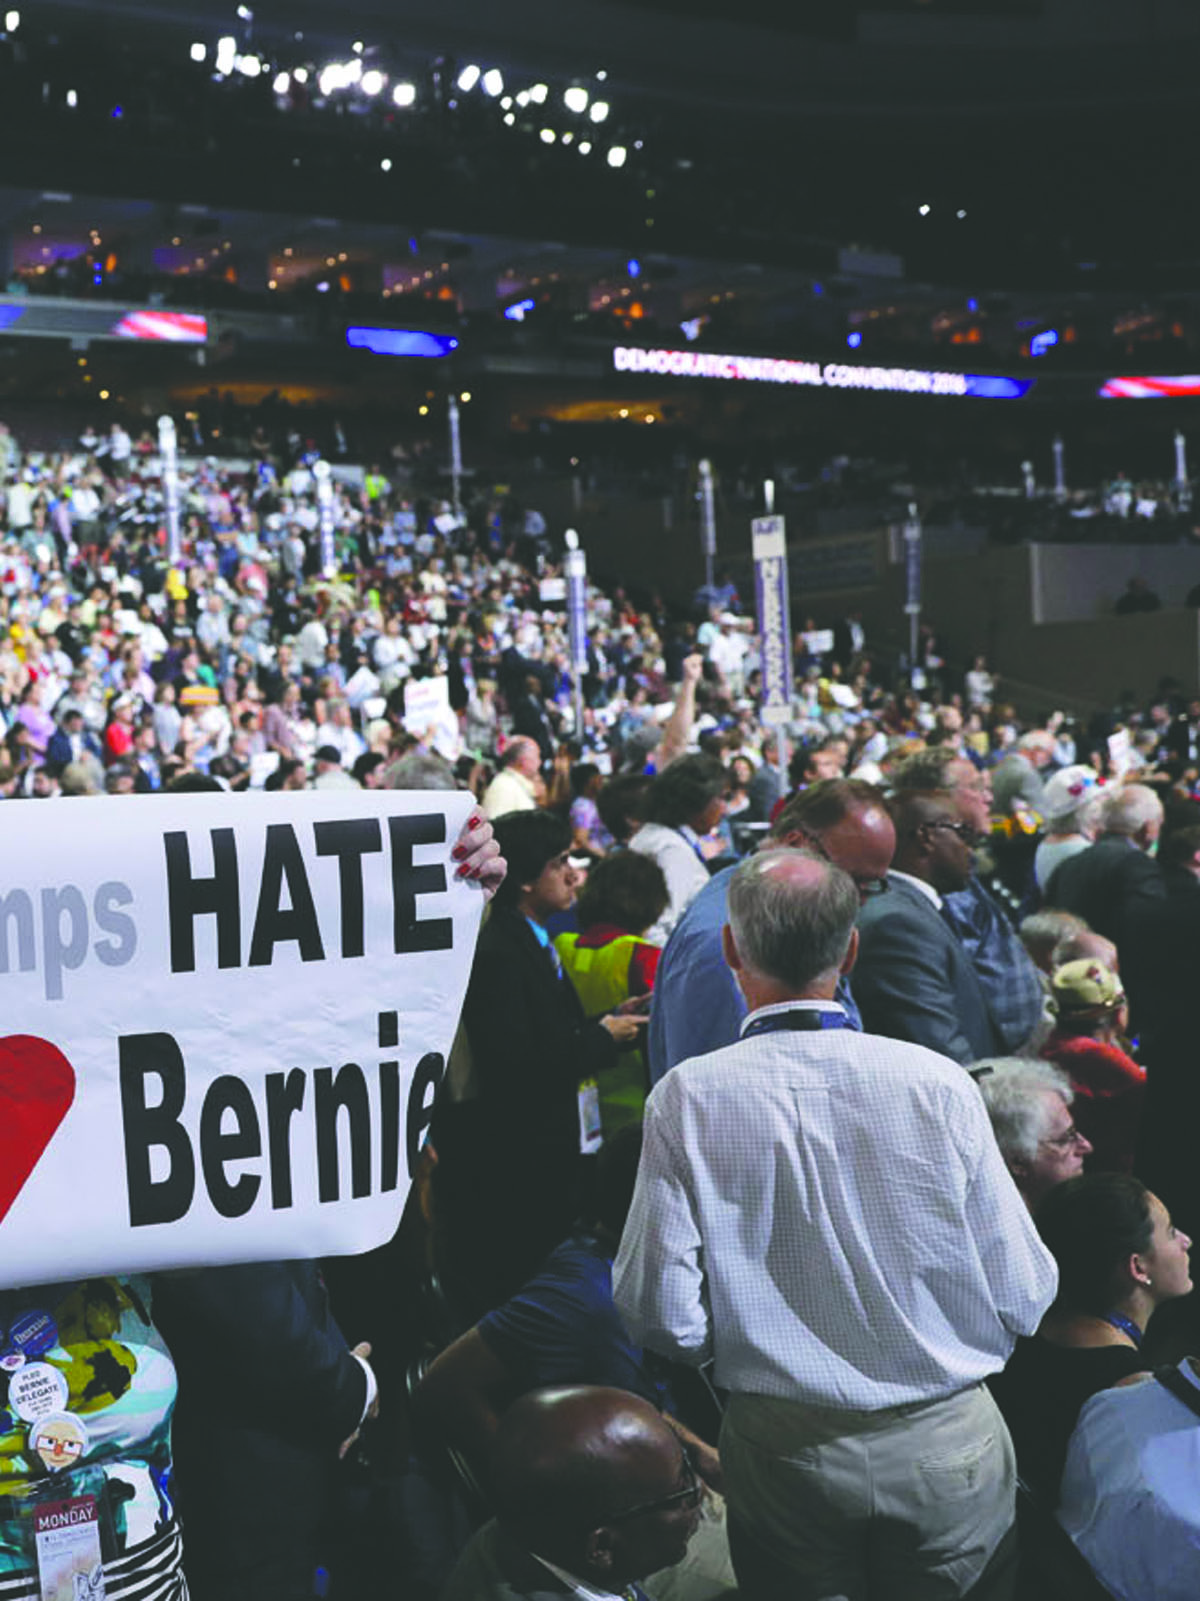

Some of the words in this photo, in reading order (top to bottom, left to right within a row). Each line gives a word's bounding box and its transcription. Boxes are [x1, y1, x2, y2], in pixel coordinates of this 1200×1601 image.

[614, 347, 735, 379] DEMOCRATIC
[163, 813, 454, 973] HATE
[118, 1010, 445, 1228] Bernie
[15, 1384, 59, 1405] DELEGATE
[38, 1506, 94, 1530] MONDAY
